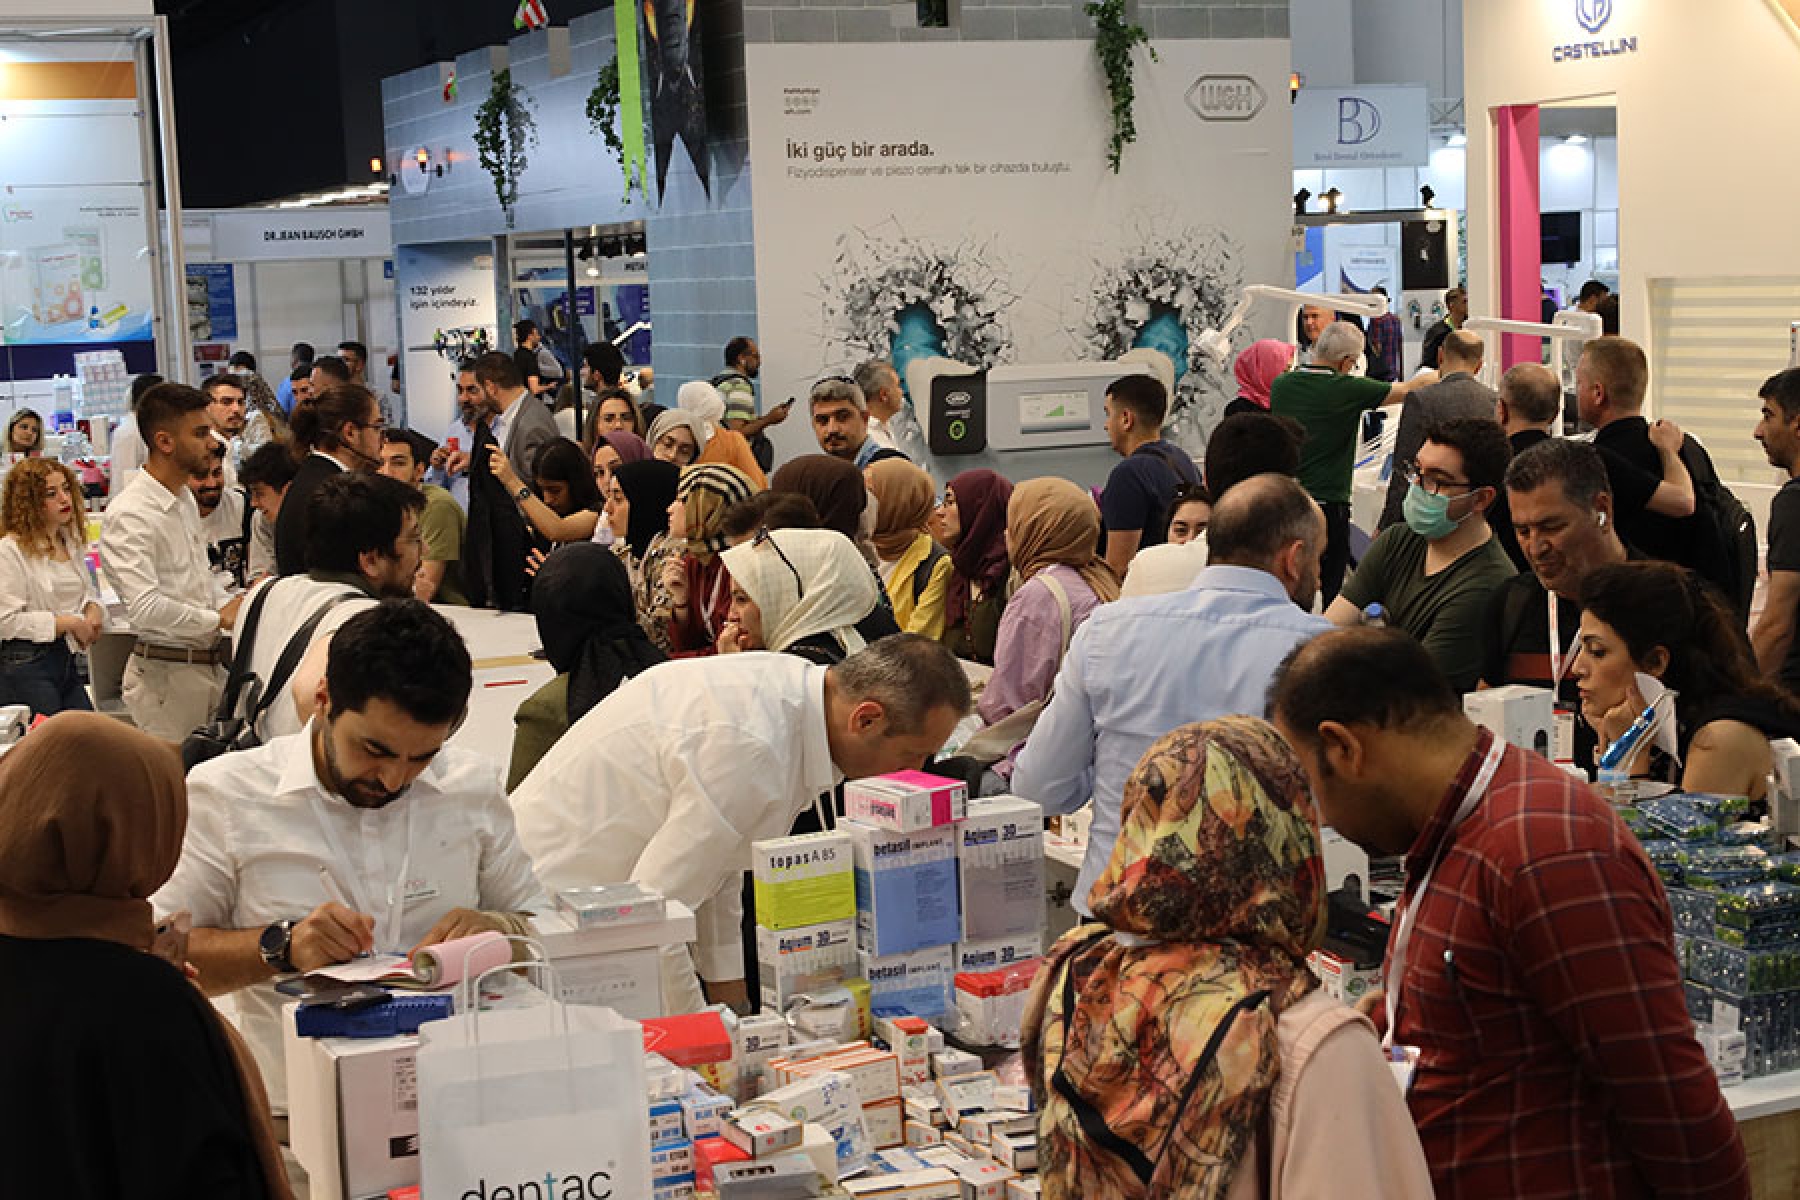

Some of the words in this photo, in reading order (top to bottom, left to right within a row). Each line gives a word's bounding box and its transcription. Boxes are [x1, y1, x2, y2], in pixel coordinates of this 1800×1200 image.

[1552, 36, 1637, 63] CASTELLINI
[785, 138, 808, 158] İki
[813, 141, 847, 162] güç
[851, 140, 876, 157] bir
[879, 139, 934, 157] arada.
[301, 230, 336, 241] BAUSCH
[624, 261, 649, 271] META
[409, 285, 429, 297] 132
[873, 839, 911, 857] betasil
[771, 853, 810, 870] topas
[868, 963, 907, 981] betasil
[460, 1171, 612, 1200] dentac
